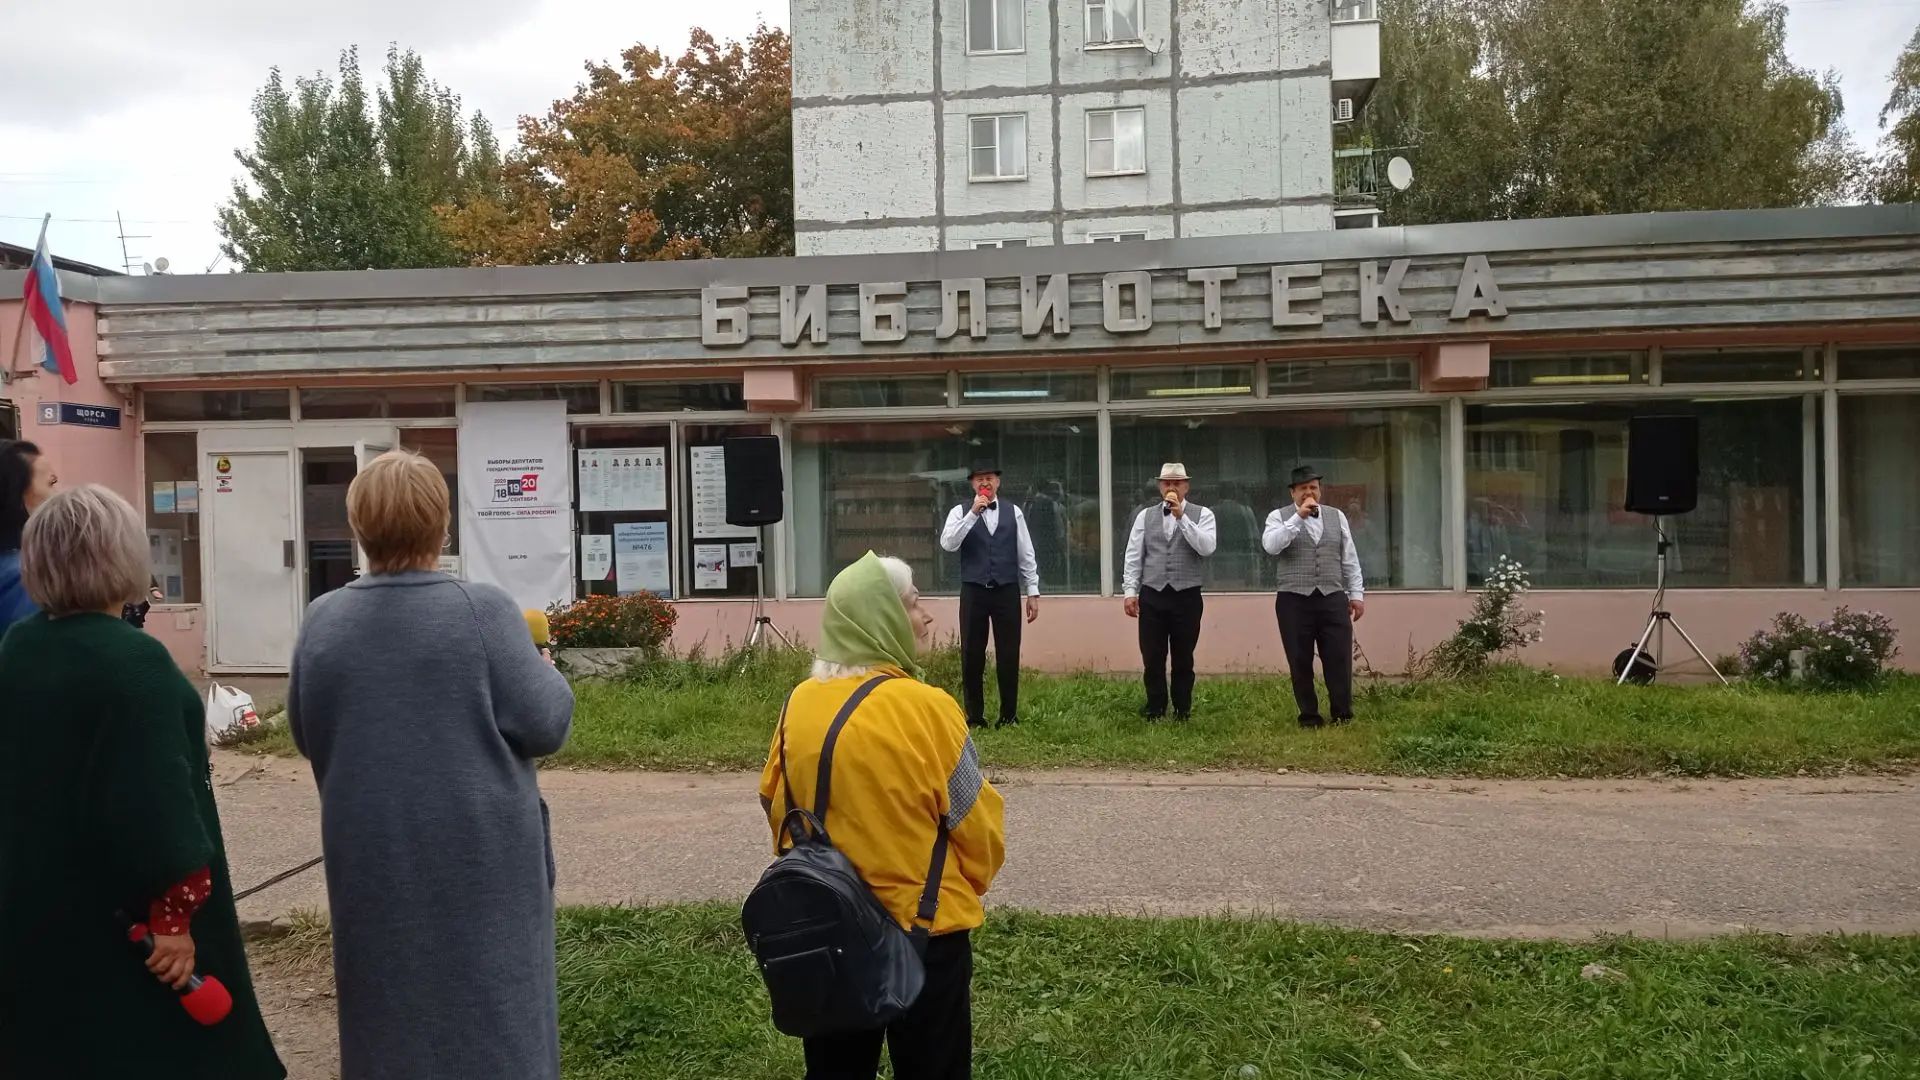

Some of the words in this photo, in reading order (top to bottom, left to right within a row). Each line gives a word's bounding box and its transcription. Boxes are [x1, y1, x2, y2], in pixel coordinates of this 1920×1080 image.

[701, 255, 1508, 347] БИБЛИОТЕКА
[44, 407, 54, 419] 8
[76, 408, 105, 418] ЩОРСА
[496, 489, 507, 498] 18
[508, 483, 520, 493] 19
[521, 478, 536, 488] 20
